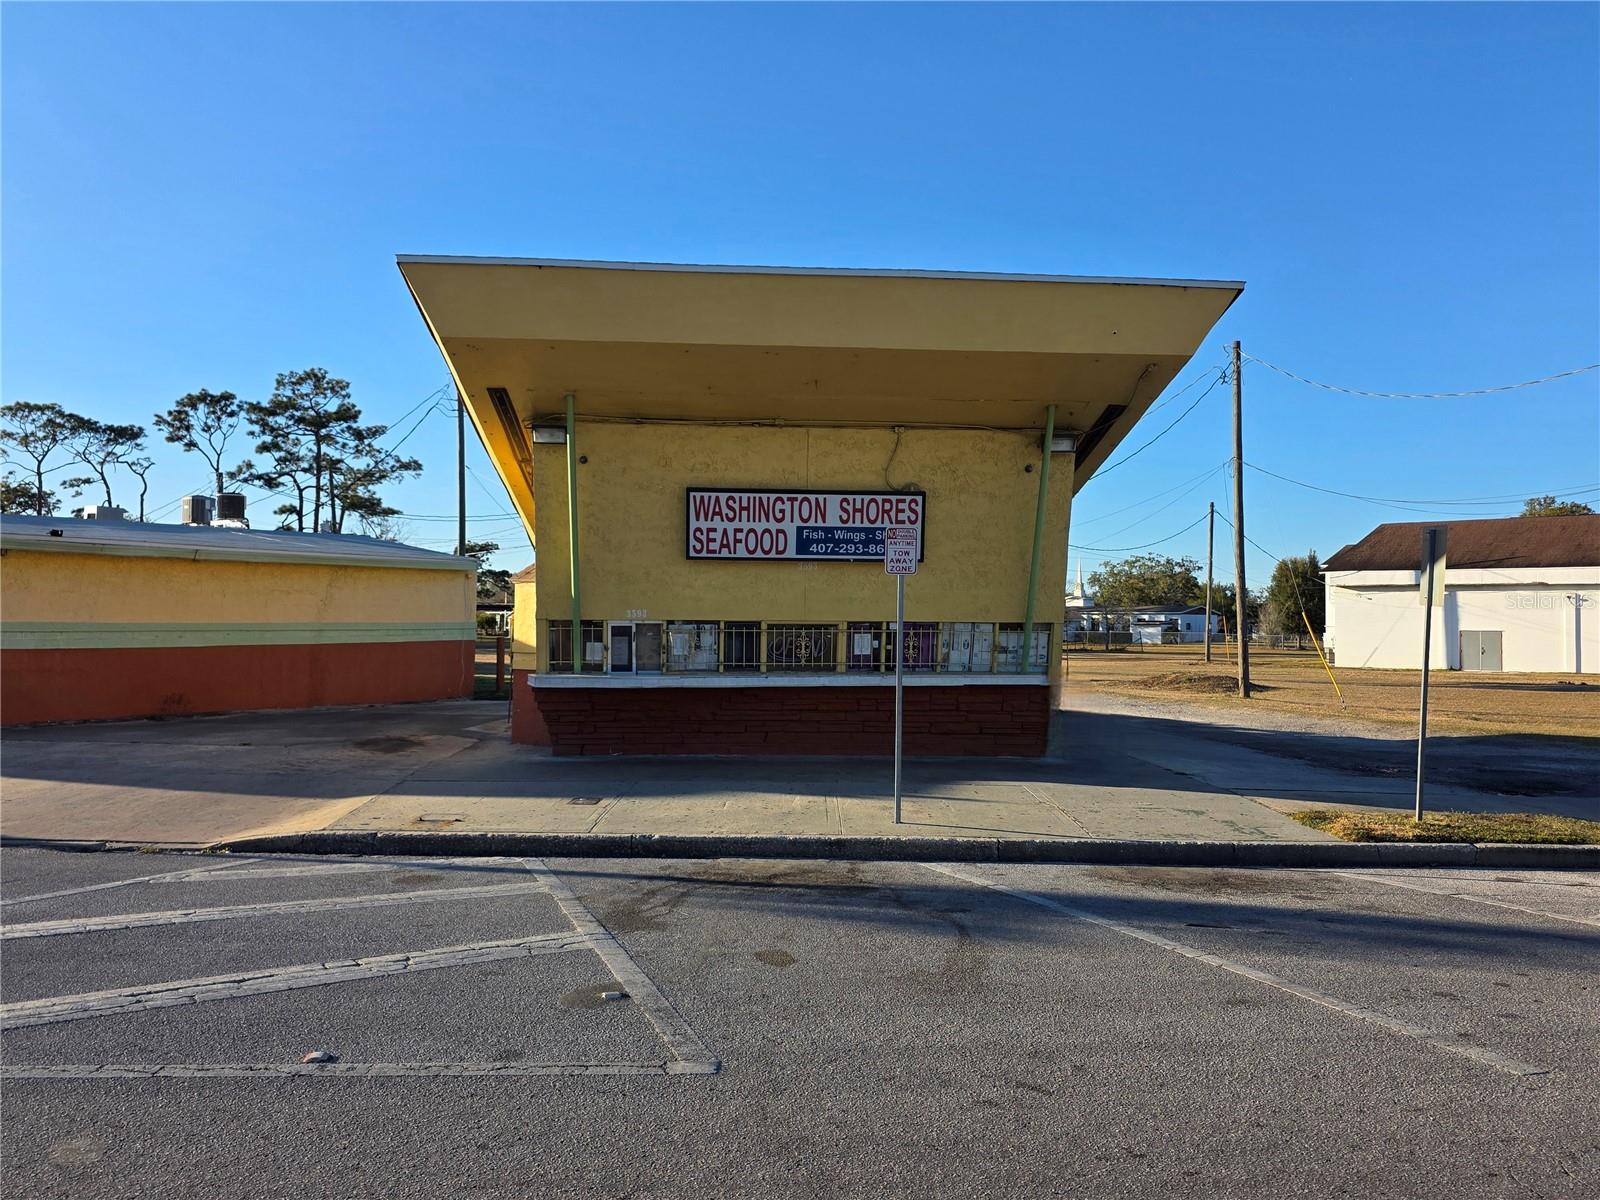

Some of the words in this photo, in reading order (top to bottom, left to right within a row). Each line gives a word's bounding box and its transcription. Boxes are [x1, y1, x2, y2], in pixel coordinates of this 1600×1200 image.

[692, 494, 827, 524] WASHINGTON
[838, 497, 919, 525] SHORES
[803, 529, 825, 540] Fish
[834, 530, 866, 542] Wings
[887, 529, 896, 538] NO
[692, 527, 788, 556] SEAFOOD
[809, 543, 885, 554] 407-293-86
